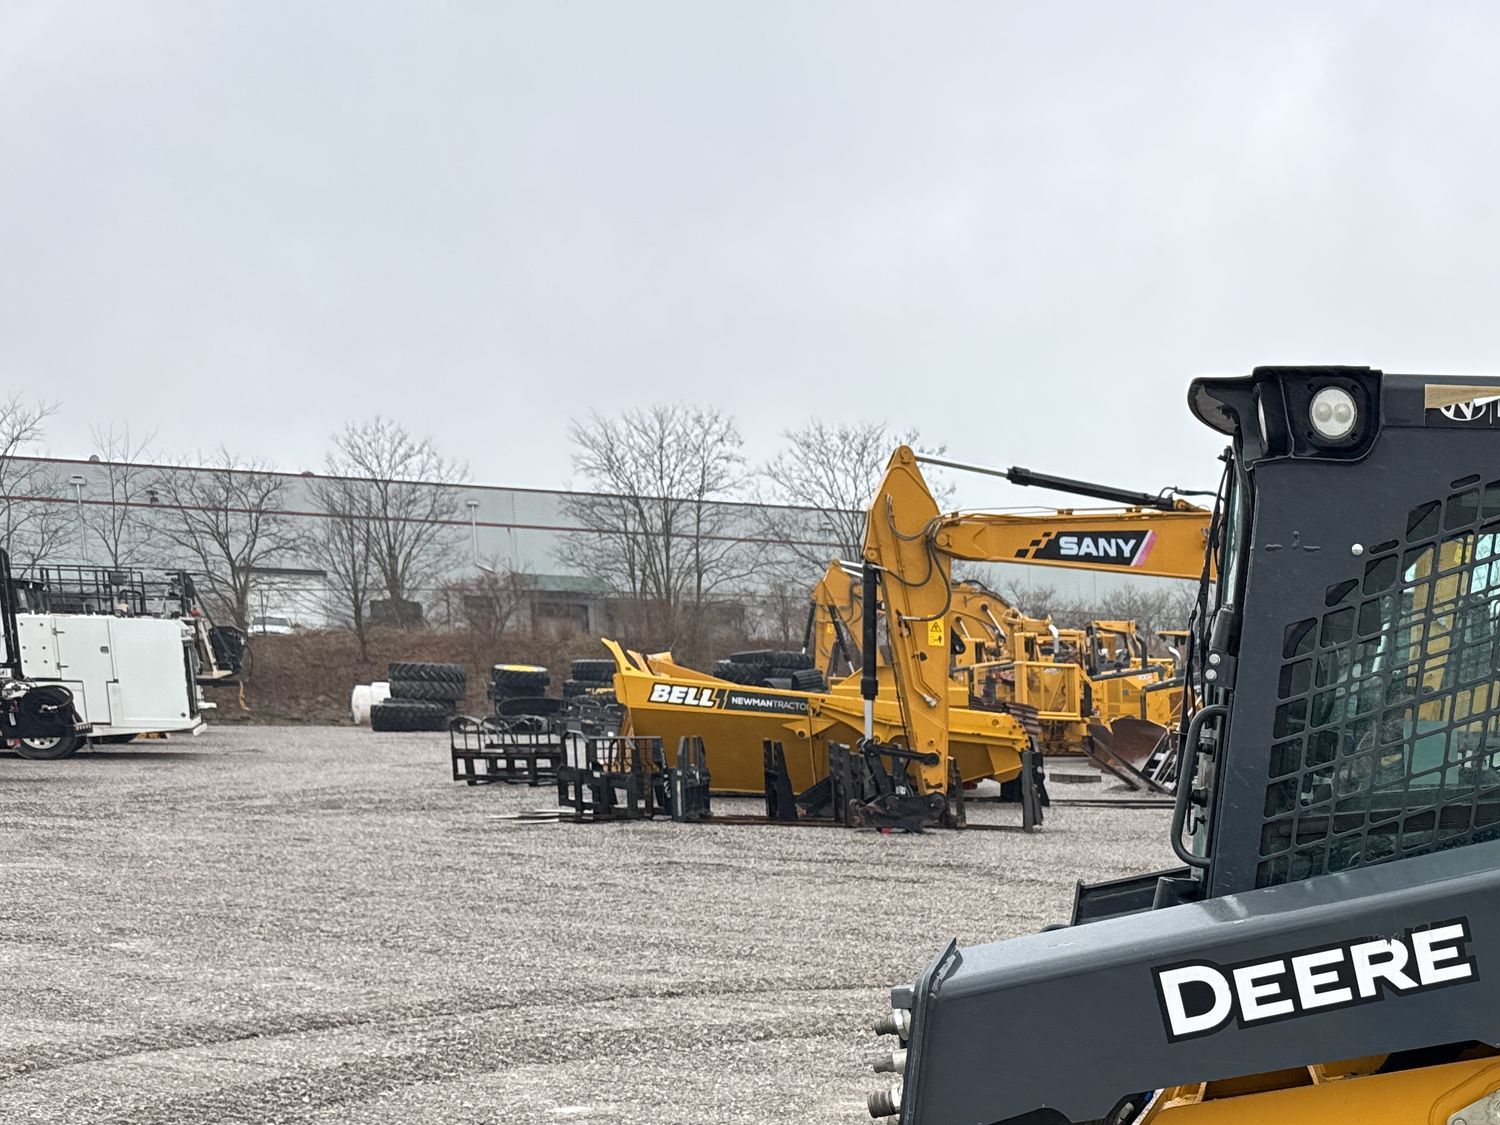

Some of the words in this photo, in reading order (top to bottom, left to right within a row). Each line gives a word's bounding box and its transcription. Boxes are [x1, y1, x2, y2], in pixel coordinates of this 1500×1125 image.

[1059, 536, 1136, 558] SANY
[650, 684, 715, 706] BELL
[731, 697, 809, 711] NEWMANTRACTO
[1159, 924, 1472, 1036] DEERE
